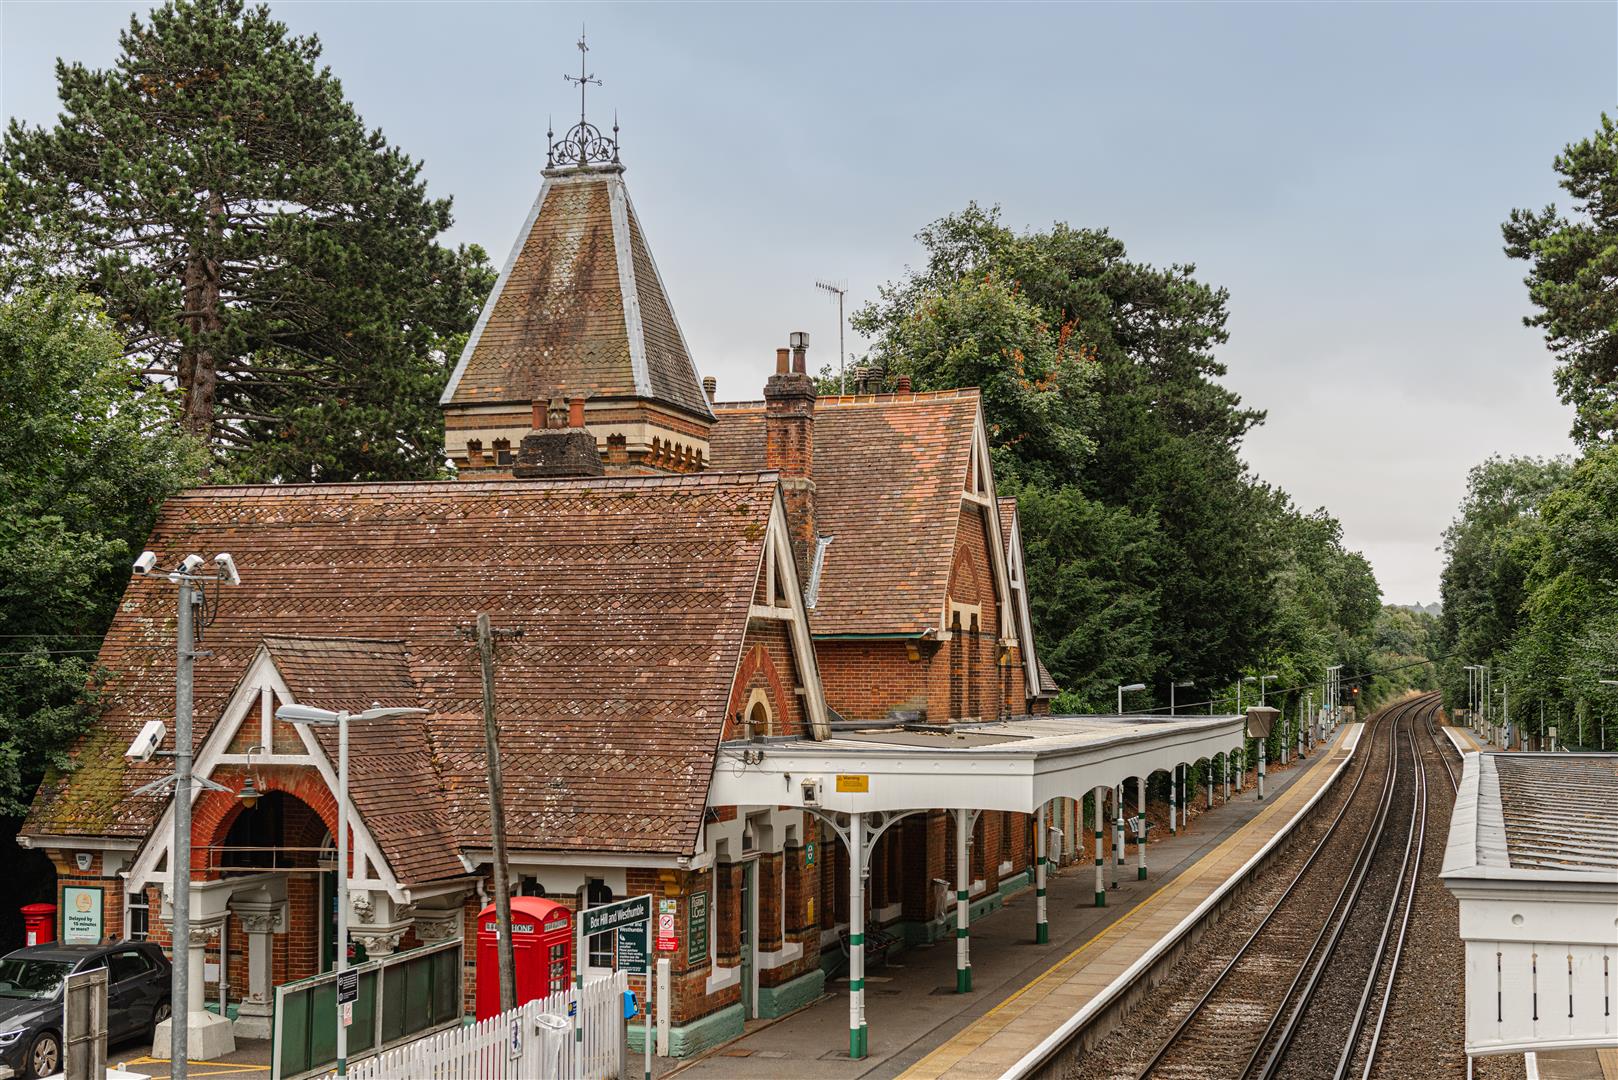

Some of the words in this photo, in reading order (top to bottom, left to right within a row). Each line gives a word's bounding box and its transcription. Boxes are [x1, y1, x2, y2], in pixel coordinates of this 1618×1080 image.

[590, 916, 600, 928] Box
[600, 912, 609, 926] Hill
[609, 910, 617, 924] and
[618, 904, 644, 920] Westhumble
